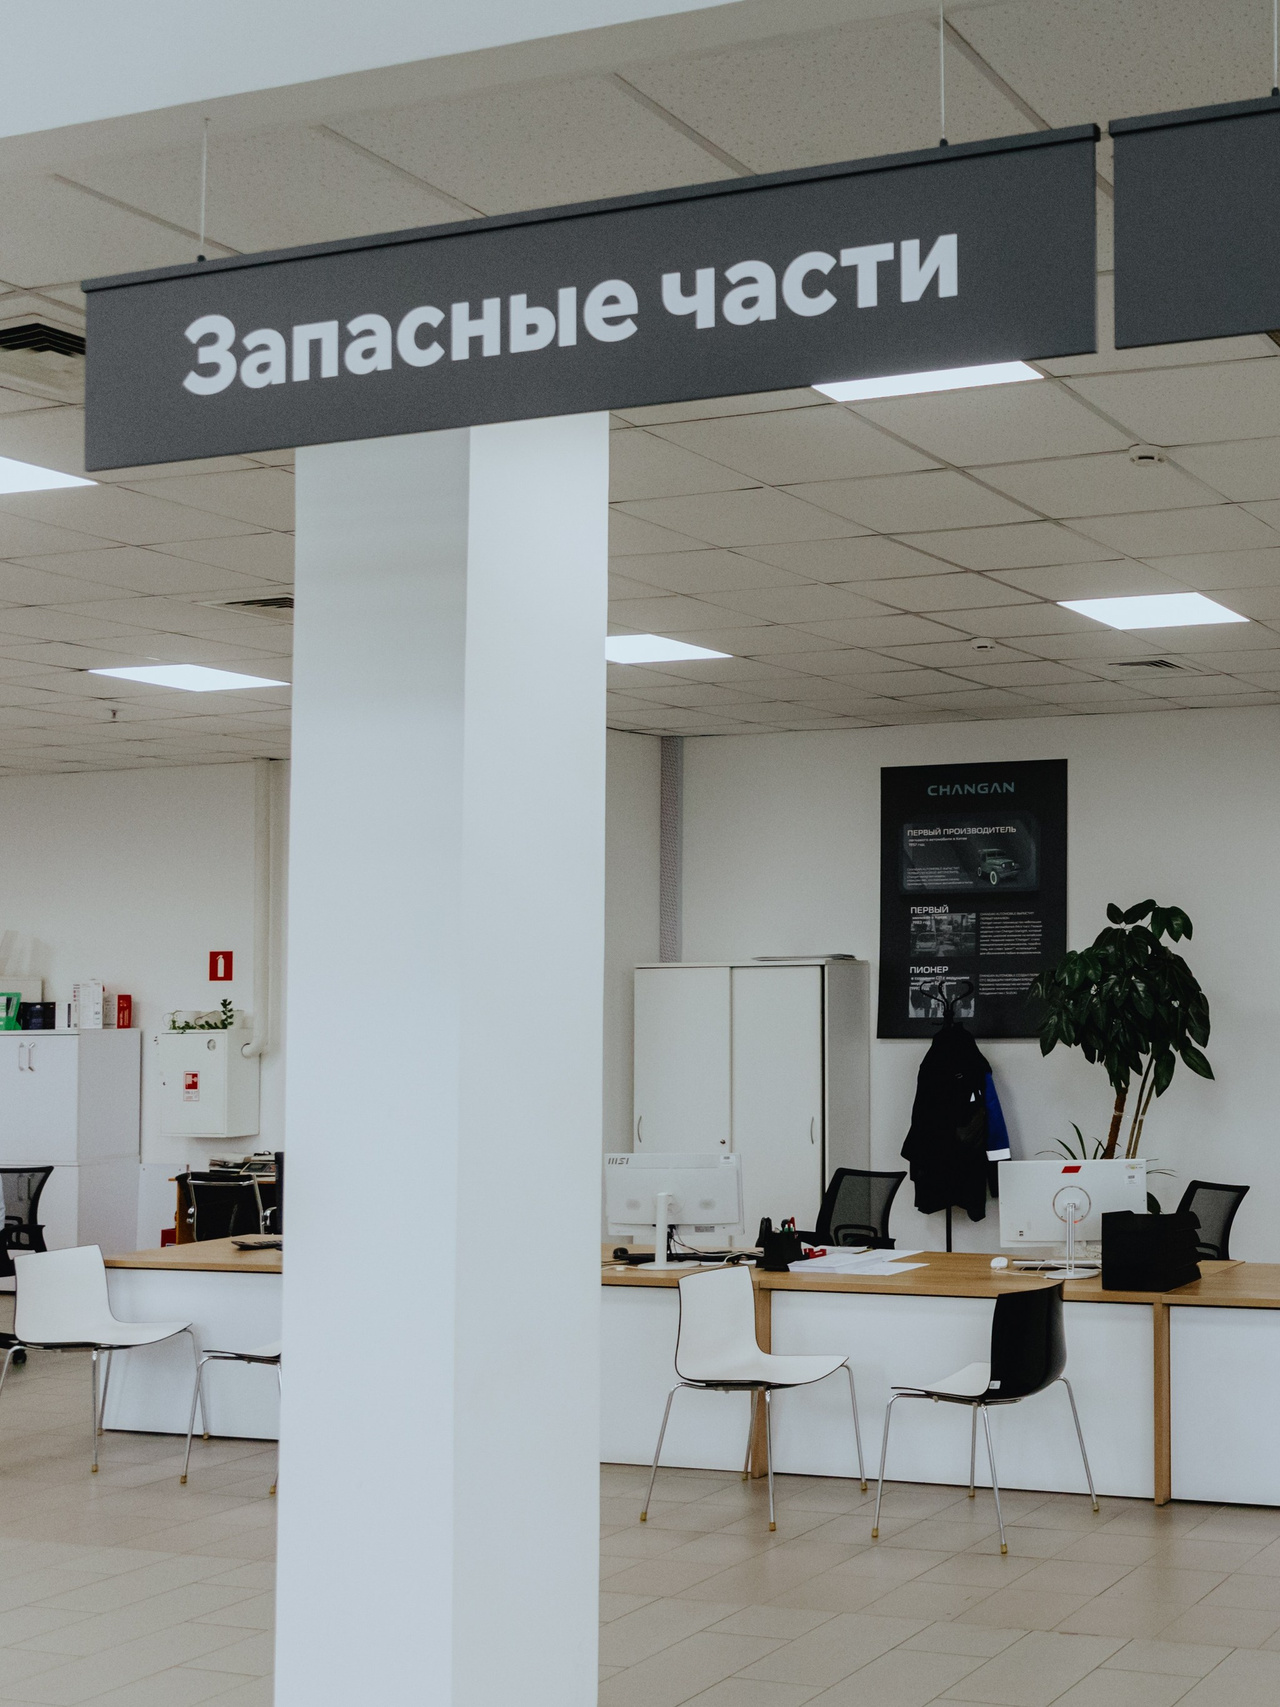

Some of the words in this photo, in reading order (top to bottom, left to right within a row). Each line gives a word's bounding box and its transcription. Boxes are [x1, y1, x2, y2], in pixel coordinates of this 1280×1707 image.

[182, 280, 639, 396] Запасные
[661, 233, 958, 330] части
[927, 782, 1015, 796] CHANGAN
[907, 828, 942, 837] ПЕРВЫЙ
[943, 826, 1017, 836] ПРОИЗВОДИТЕЛЬ
[910, 904, 949, 914] ПЕРВЫЙ
[909, 966, 949, 974] ПИОНЕР
